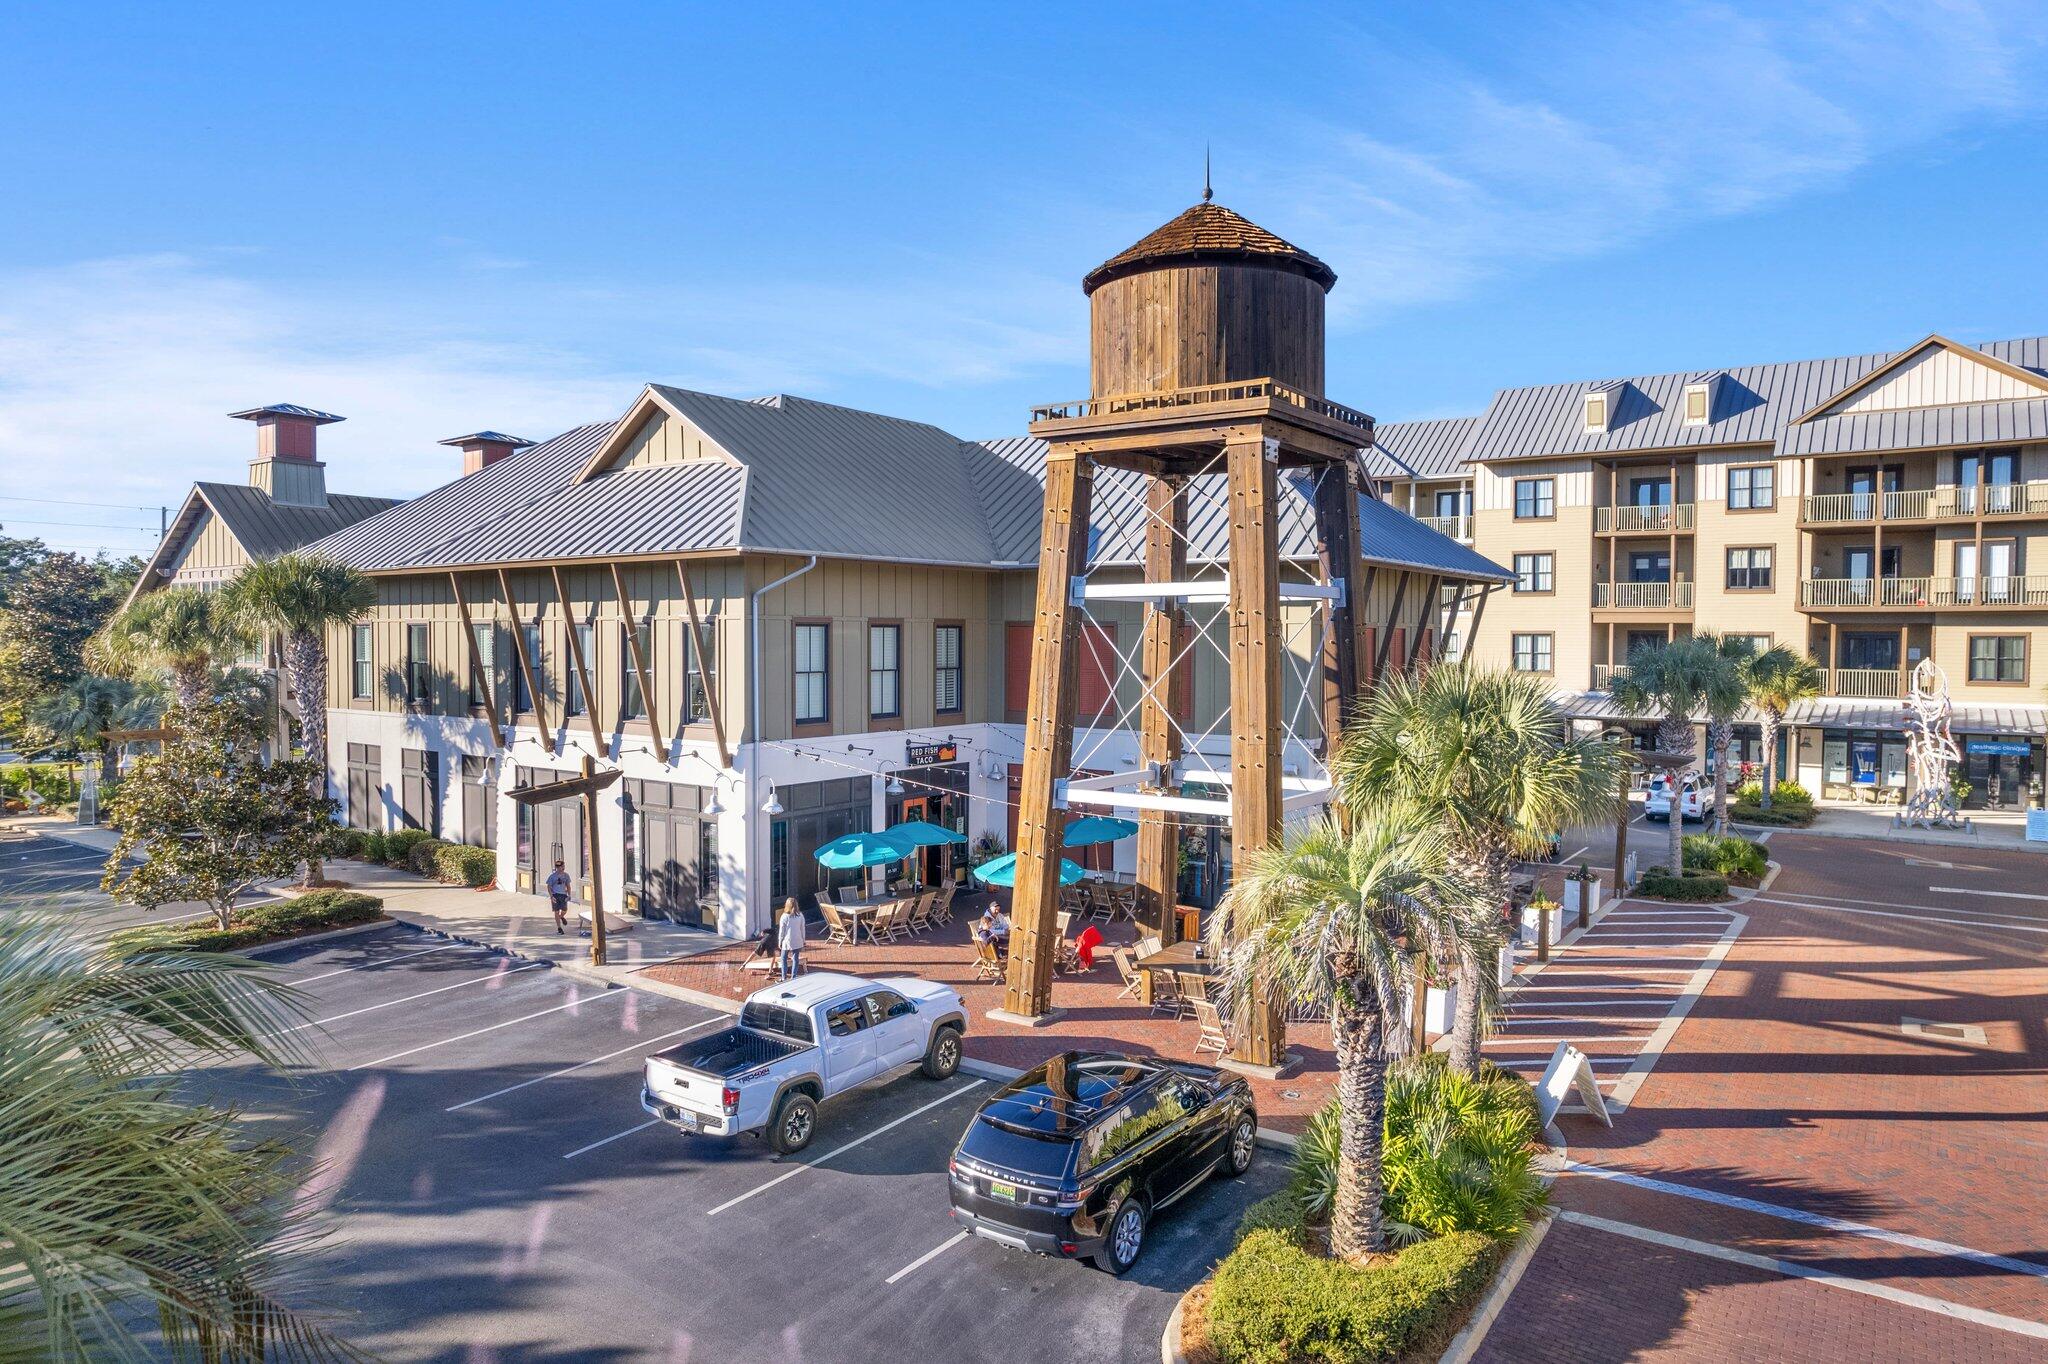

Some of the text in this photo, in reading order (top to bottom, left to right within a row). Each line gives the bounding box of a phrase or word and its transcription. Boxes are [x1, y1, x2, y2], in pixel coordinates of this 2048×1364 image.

[911, 747, 938, 756] RED FISH
[1003, 1174, 1036, 1186] ROVER
